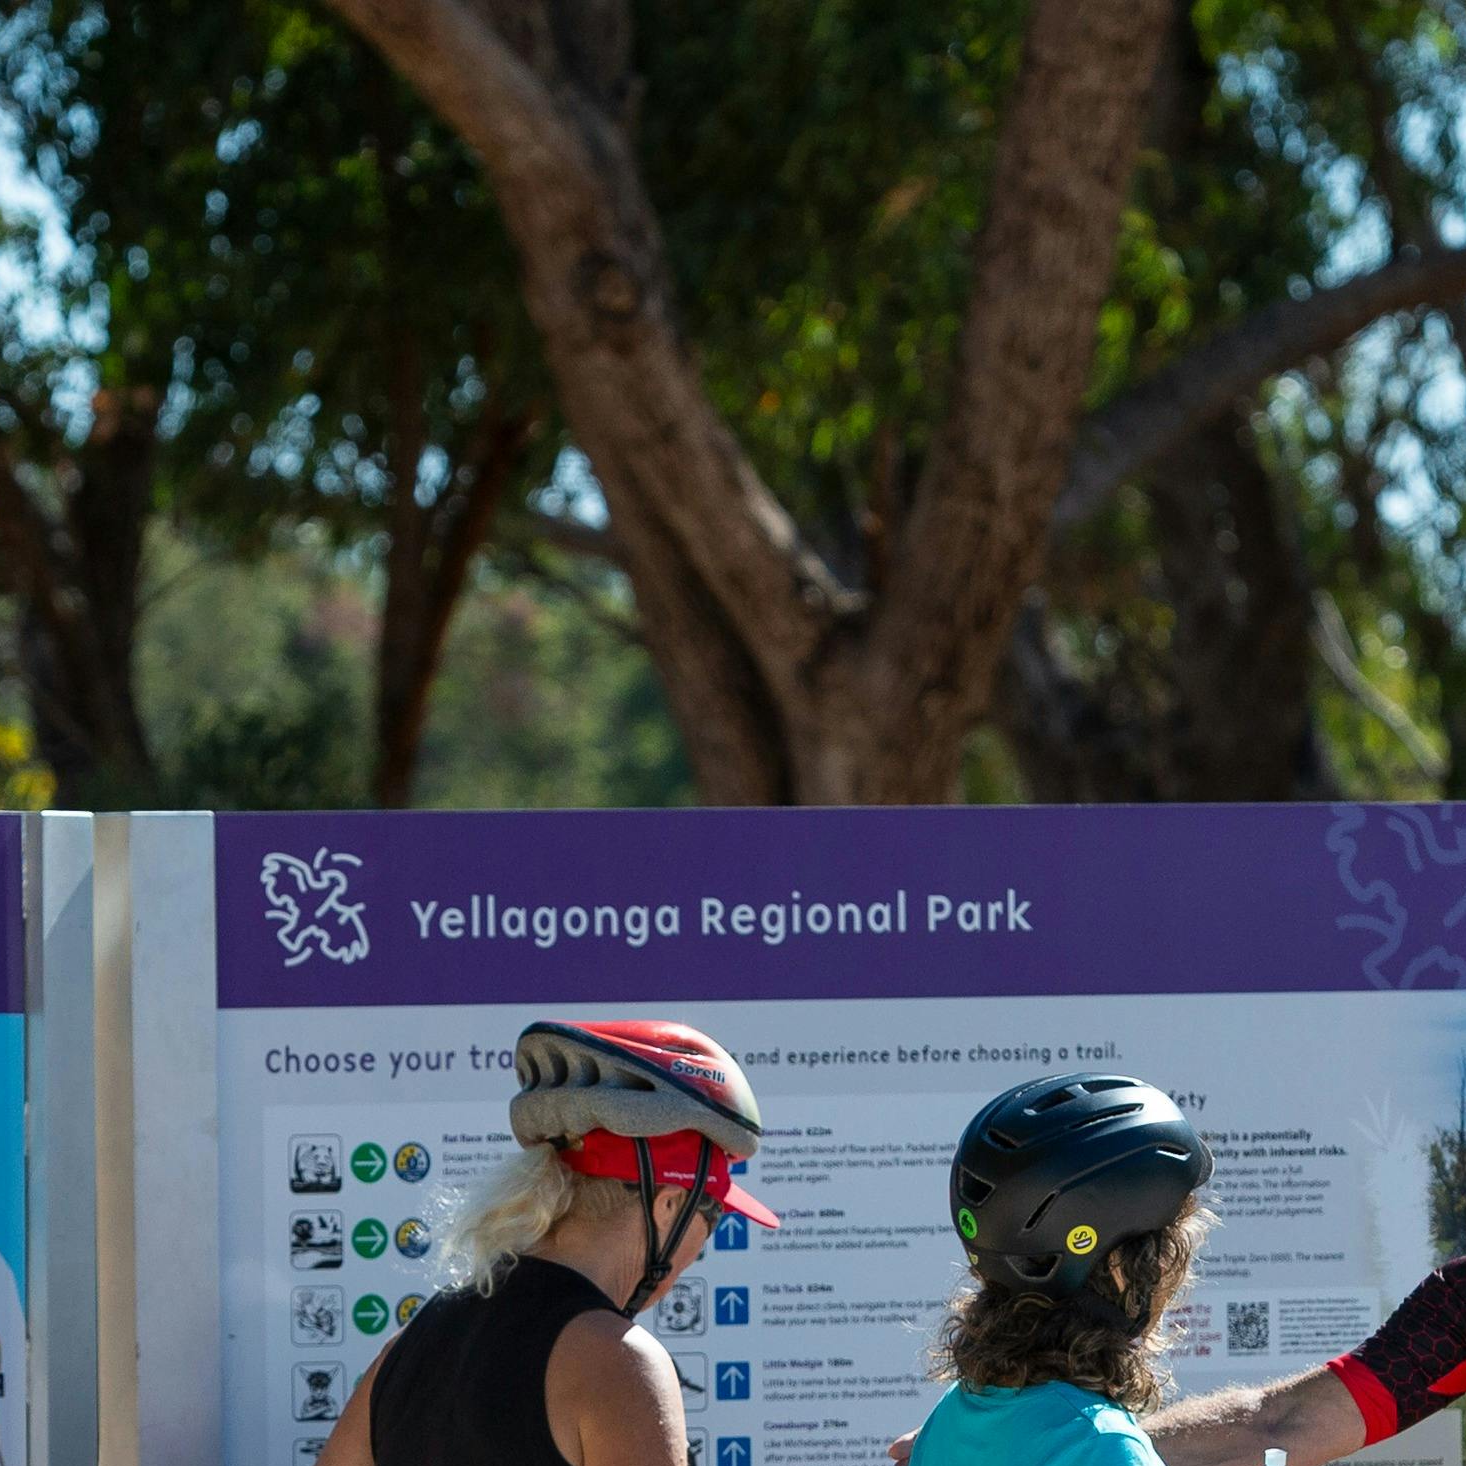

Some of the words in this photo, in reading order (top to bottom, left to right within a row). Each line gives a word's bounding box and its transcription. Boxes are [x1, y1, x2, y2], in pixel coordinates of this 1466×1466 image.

[411, 895, 680, 947] Yellagonga
[701, 890, 907, 944] Regional
[928, 889, 1033, 933] Park
[265, 1045, 376, 1074] Choose
[389, 1050, 455, 1079] your
[468, 1045, 515, 1070] tra
[744, 1047, 780, 1067] and
[787, 1046, 889, 1068] experience
[897, 1045, 961, 1063] before
[968, 1043, 1052, 1064] choosing
[1058, 1047, 1068, 1061] a
[1076, 1042, 1123, 1061] trail.
[671, 1061, 726, 1084] Sorelli
[1250, 1128, 1312, 1143] potentially
[1243, 1147, 1268, 1158] with
[1270, 1146, 1316, 1157] inherent
[1319, 1145, 1349, 1157] risks.
